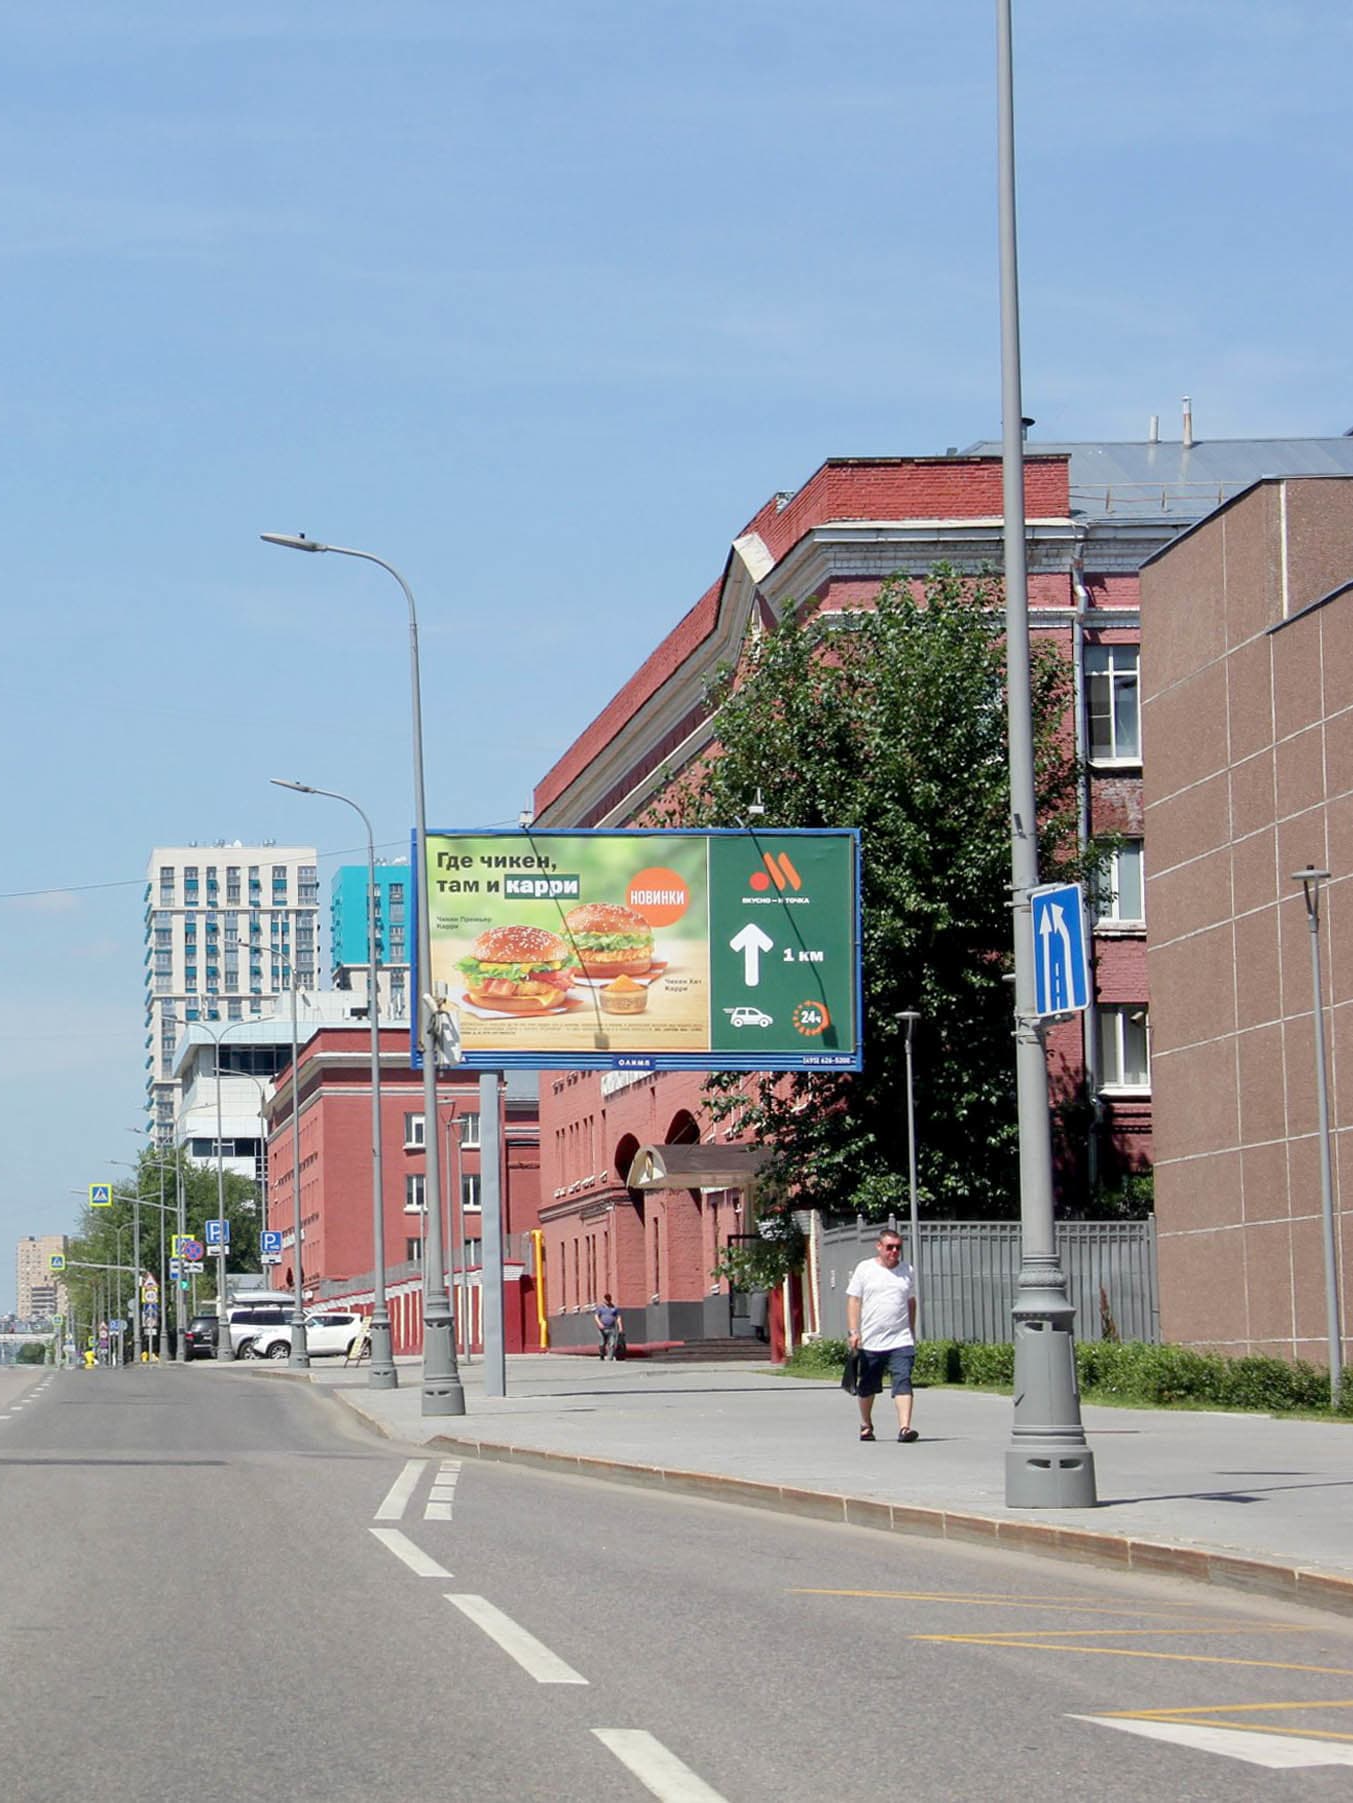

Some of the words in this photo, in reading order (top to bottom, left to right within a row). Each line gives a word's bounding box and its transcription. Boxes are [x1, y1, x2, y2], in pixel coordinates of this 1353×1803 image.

[436, 851, 474, 871] Где
[479, 855, 558, 872] чикен,
[436, 879, 480, 893] там
[486, 879, 500, 893] и
[505, 879, 579, 898] карри
[630, 889, 685, 905] НОВИНКИ
[783, 948, 795, 962] 1
[798, 951, 824, 962] км
